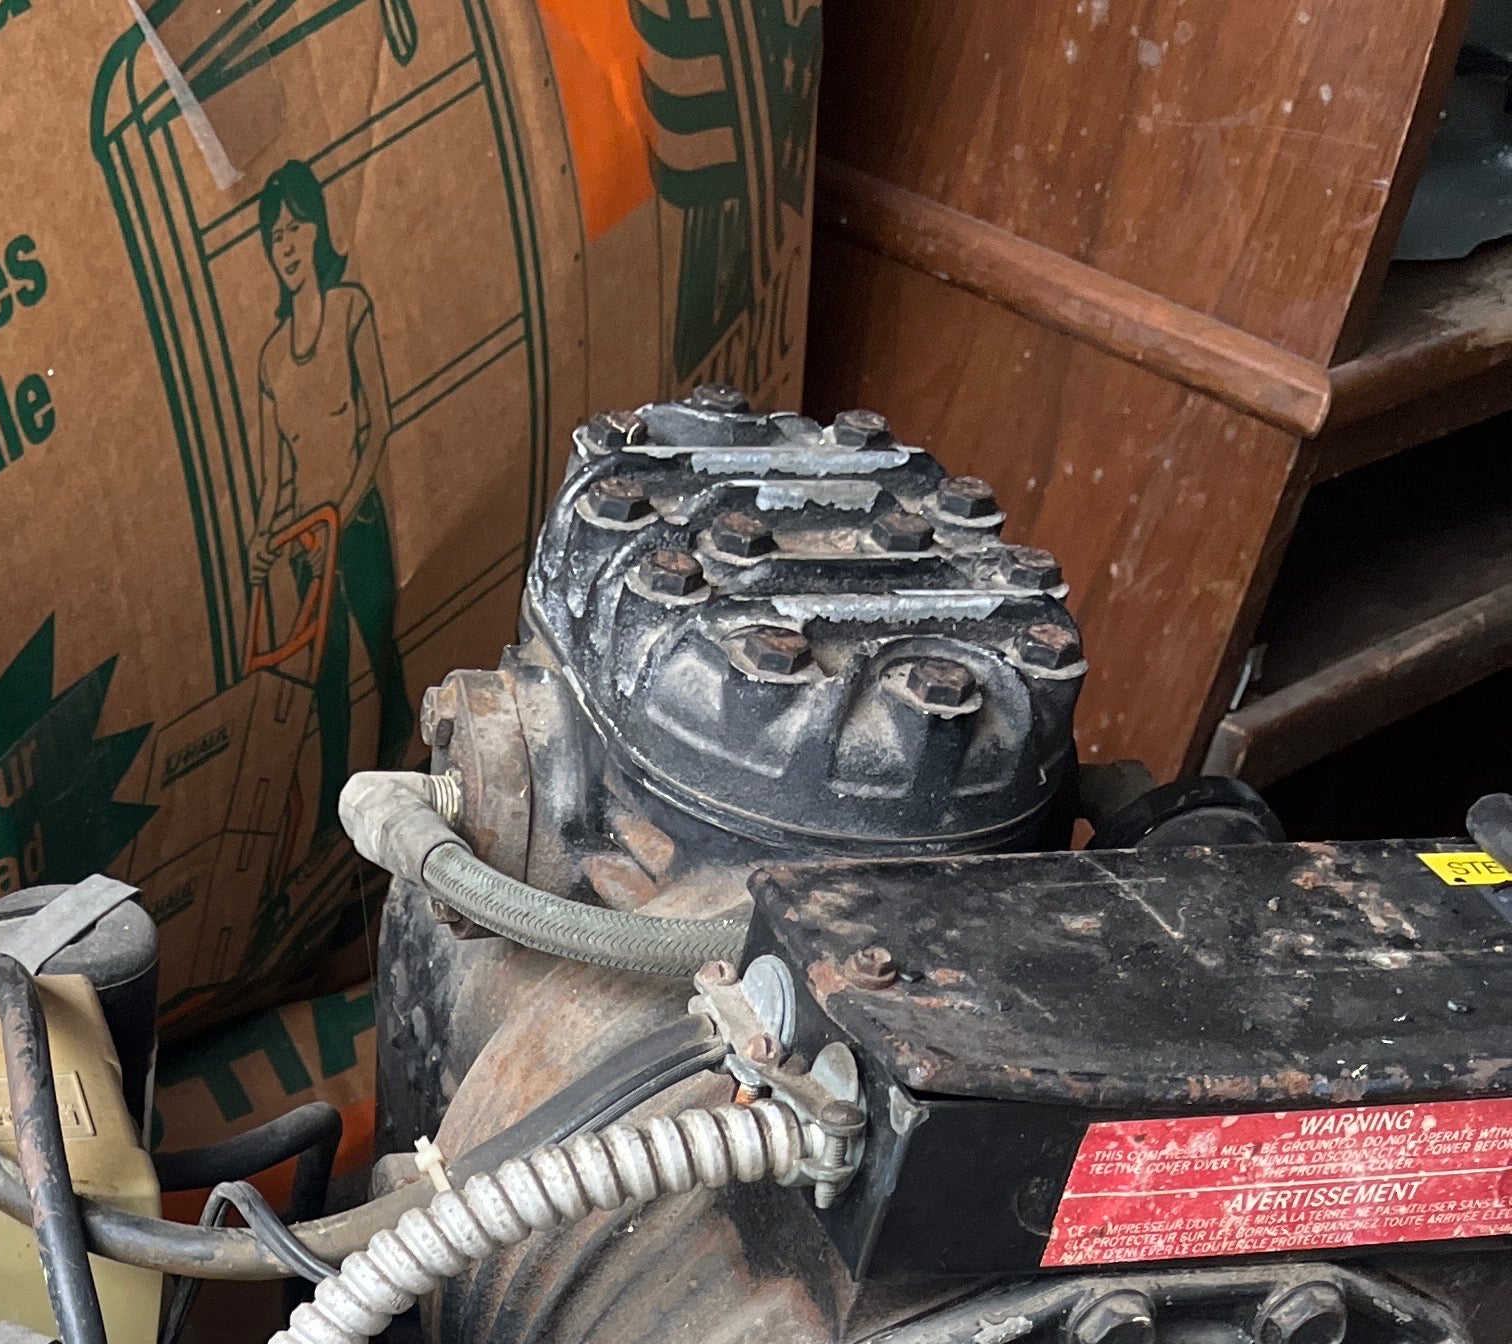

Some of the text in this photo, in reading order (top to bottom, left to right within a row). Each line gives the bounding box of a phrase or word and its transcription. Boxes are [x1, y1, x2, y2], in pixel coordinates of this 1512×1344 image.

[1447, 861, 1506, 875] STE
[1300, 1109, 1415, 1136] WARNING
[1089, 1161, 1142, 1176] TECTIVE
[1146, 1159, 1190, 1175] COVER
[1193, 1157, 1229, 1171] OVER
[1311, 1147, 1395, 1164] DISCONNECT
[1424, 1141, 1471, 1156] POWER
[1474, 1138, 1512, 1152] BEFOR
[1094, 1149, 1124, 1161] THIS
[1260, 1141, 1278, 1155] BE
[1361, 1135, 1384, 1148] DO
[1385, 1131, 1416, 1146] NOT
[1417, 1127, 1476, 1143] OPERATE
[1478, 1125, 1512, 1140] WITH
[1262, 1165, 1286, 1178] THE
[1228, 1180, 1423, 1213] AVERTISSEMENT
[1067, 1225, 1087, 1238] CE
[1254, 1213, 1277, 1225] MIS
[1290, 1211, 1306, 1222] LA
[1354, 1205, 1371, 1217] NE
[1458, 1197, 1489, 1211] SANS
[1491, 1193, 1507, 1208] LE
[1091, 1231, 1177, 1248] PROTECTEUR
[1180, 1230, 1206, 1242] SUR
[1384, 1214, 1424, 1228] TOUTE
[1174, 1242, 1189, 1256] LE
